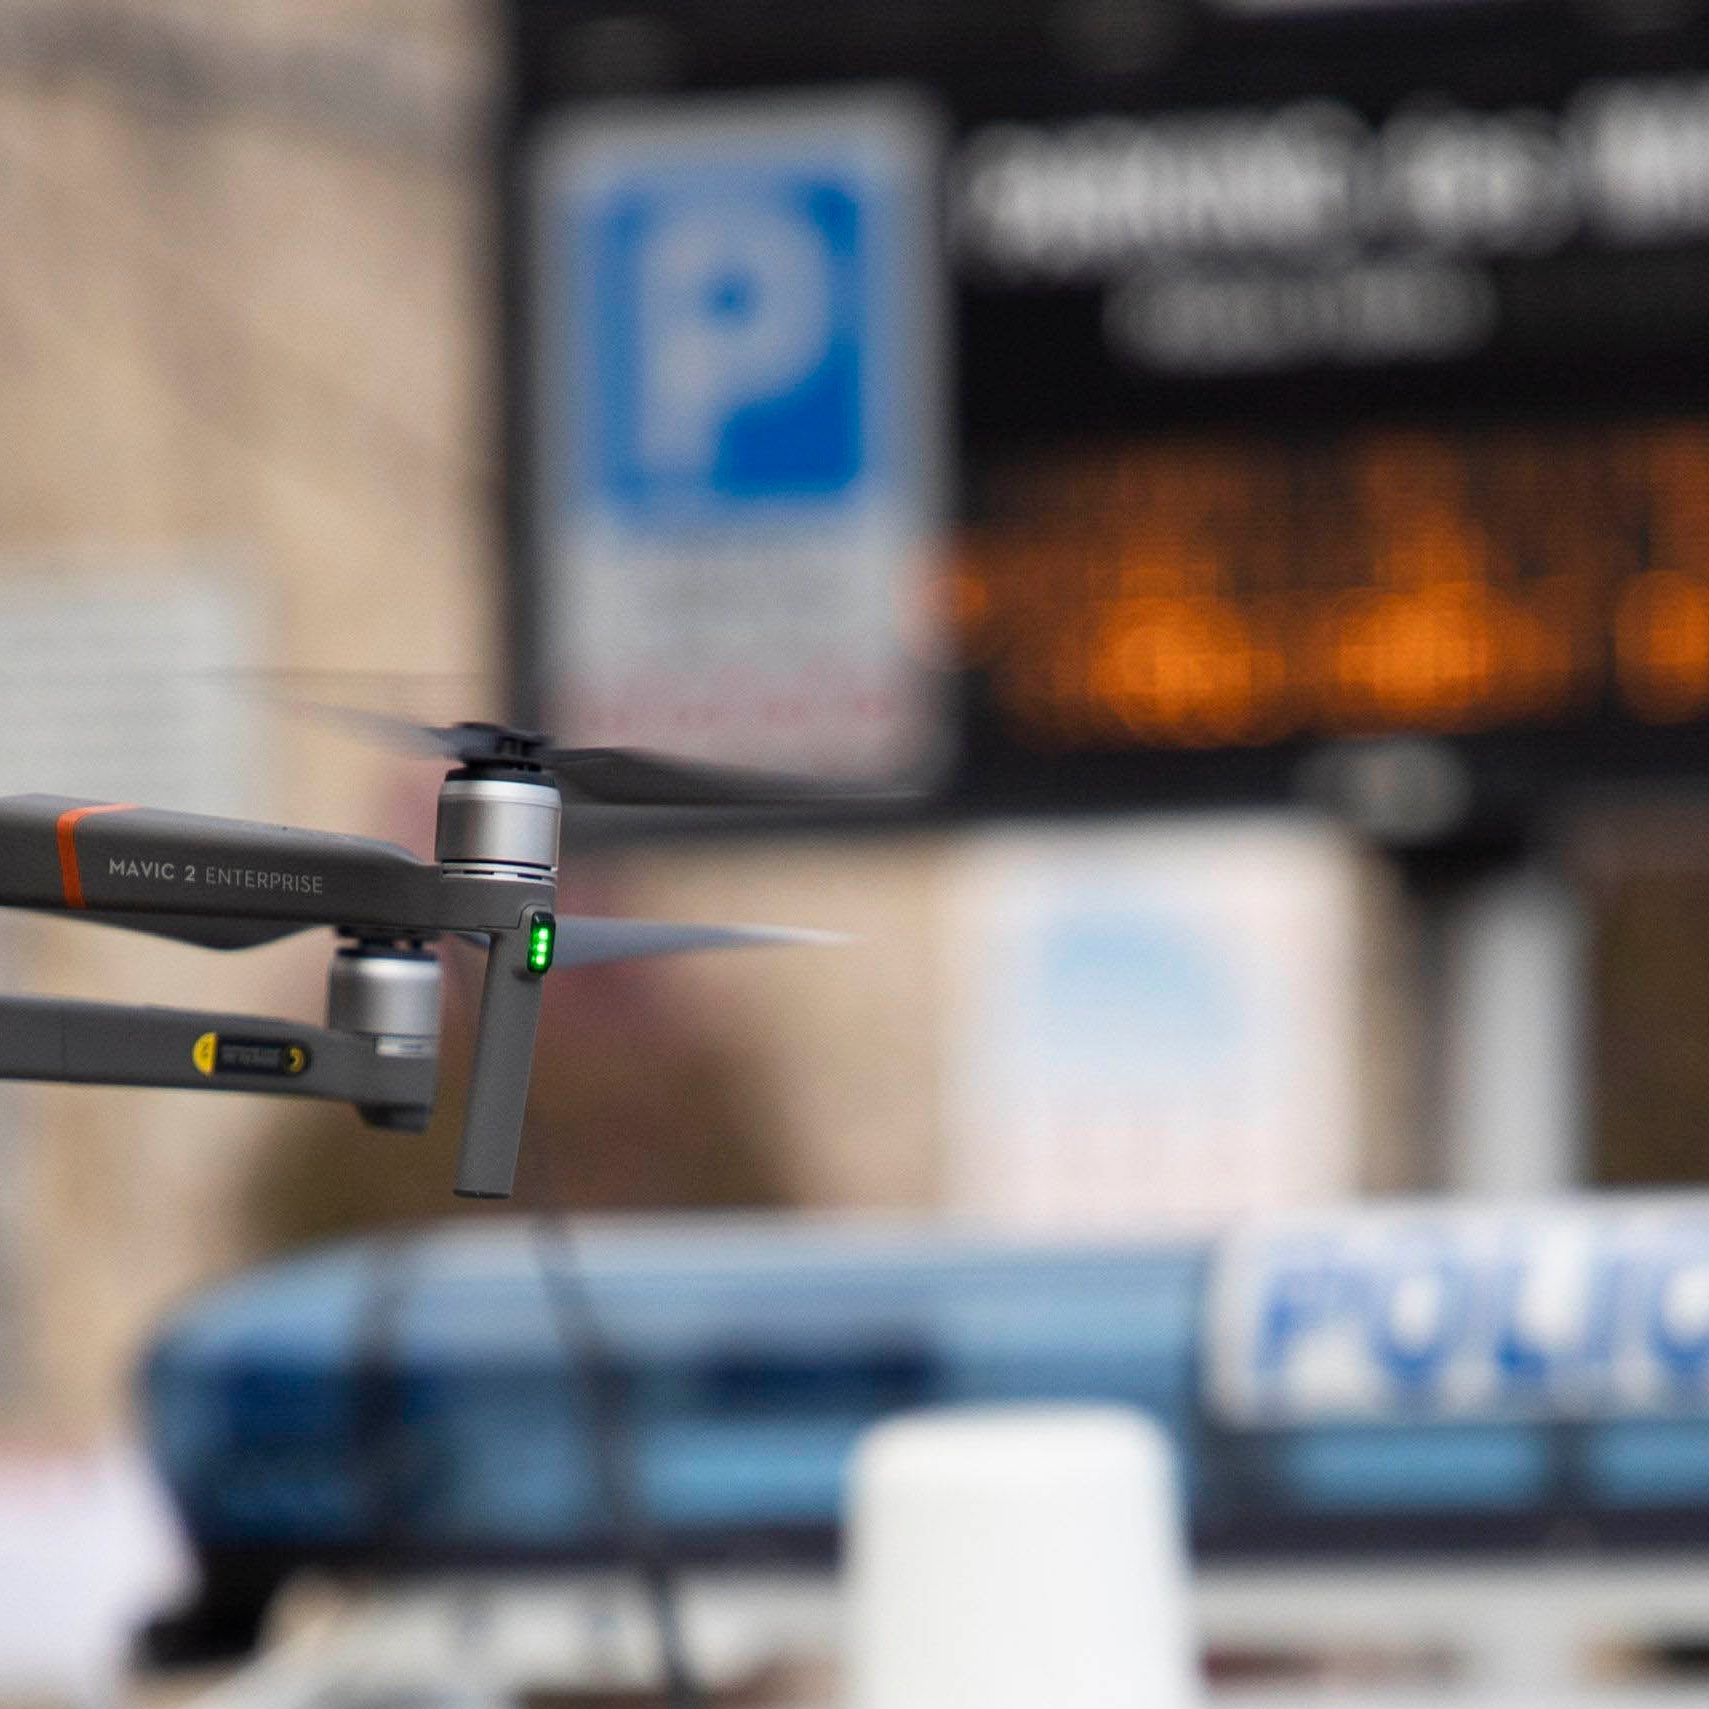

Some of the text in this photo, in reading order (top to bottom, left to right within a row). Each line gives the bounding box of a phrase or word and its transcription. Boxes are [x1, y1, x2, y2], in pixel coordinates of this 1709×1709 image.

[629, 192, 836, 482] P
[108, 857, 324, 894] MAVIC 2 ENTERPRISE
